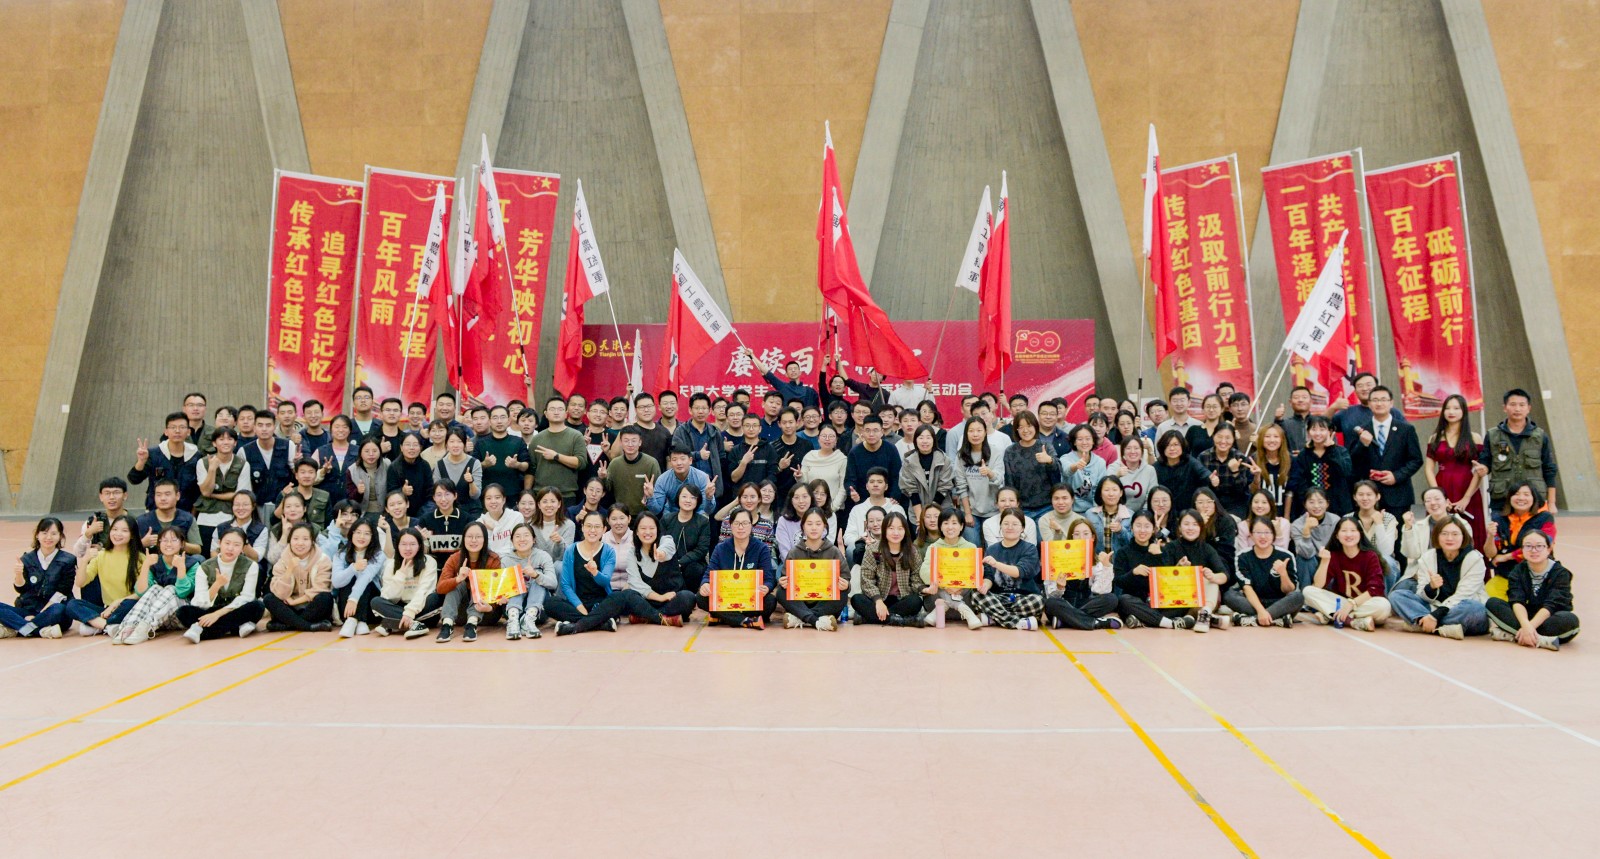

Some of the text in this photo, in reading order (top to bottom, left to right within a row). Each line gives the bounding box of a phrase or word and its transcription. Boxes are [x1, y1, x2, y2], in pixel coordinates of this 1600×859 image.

[278, 199, 315, 354] 传承红色基因
[307, 230, 346, 383] 追寻红色记忆
[370, 210, 407, 326] 百年风雨
[503, 228, 543, 376] 芳华映初心
[1164, 193, 1201, 350] 传承红色基因
[1197, 212, 1243, 372] 汲取前行力量
[1280, 185, 1317, 311] 一百年泽润
[1384, 205, 1432, 324] 百年征程
[1425, 226, 1464, 347] 砥砺前行
[599, 339, 642, 351] 天津大
[1342, 569, 1362, 599] R
